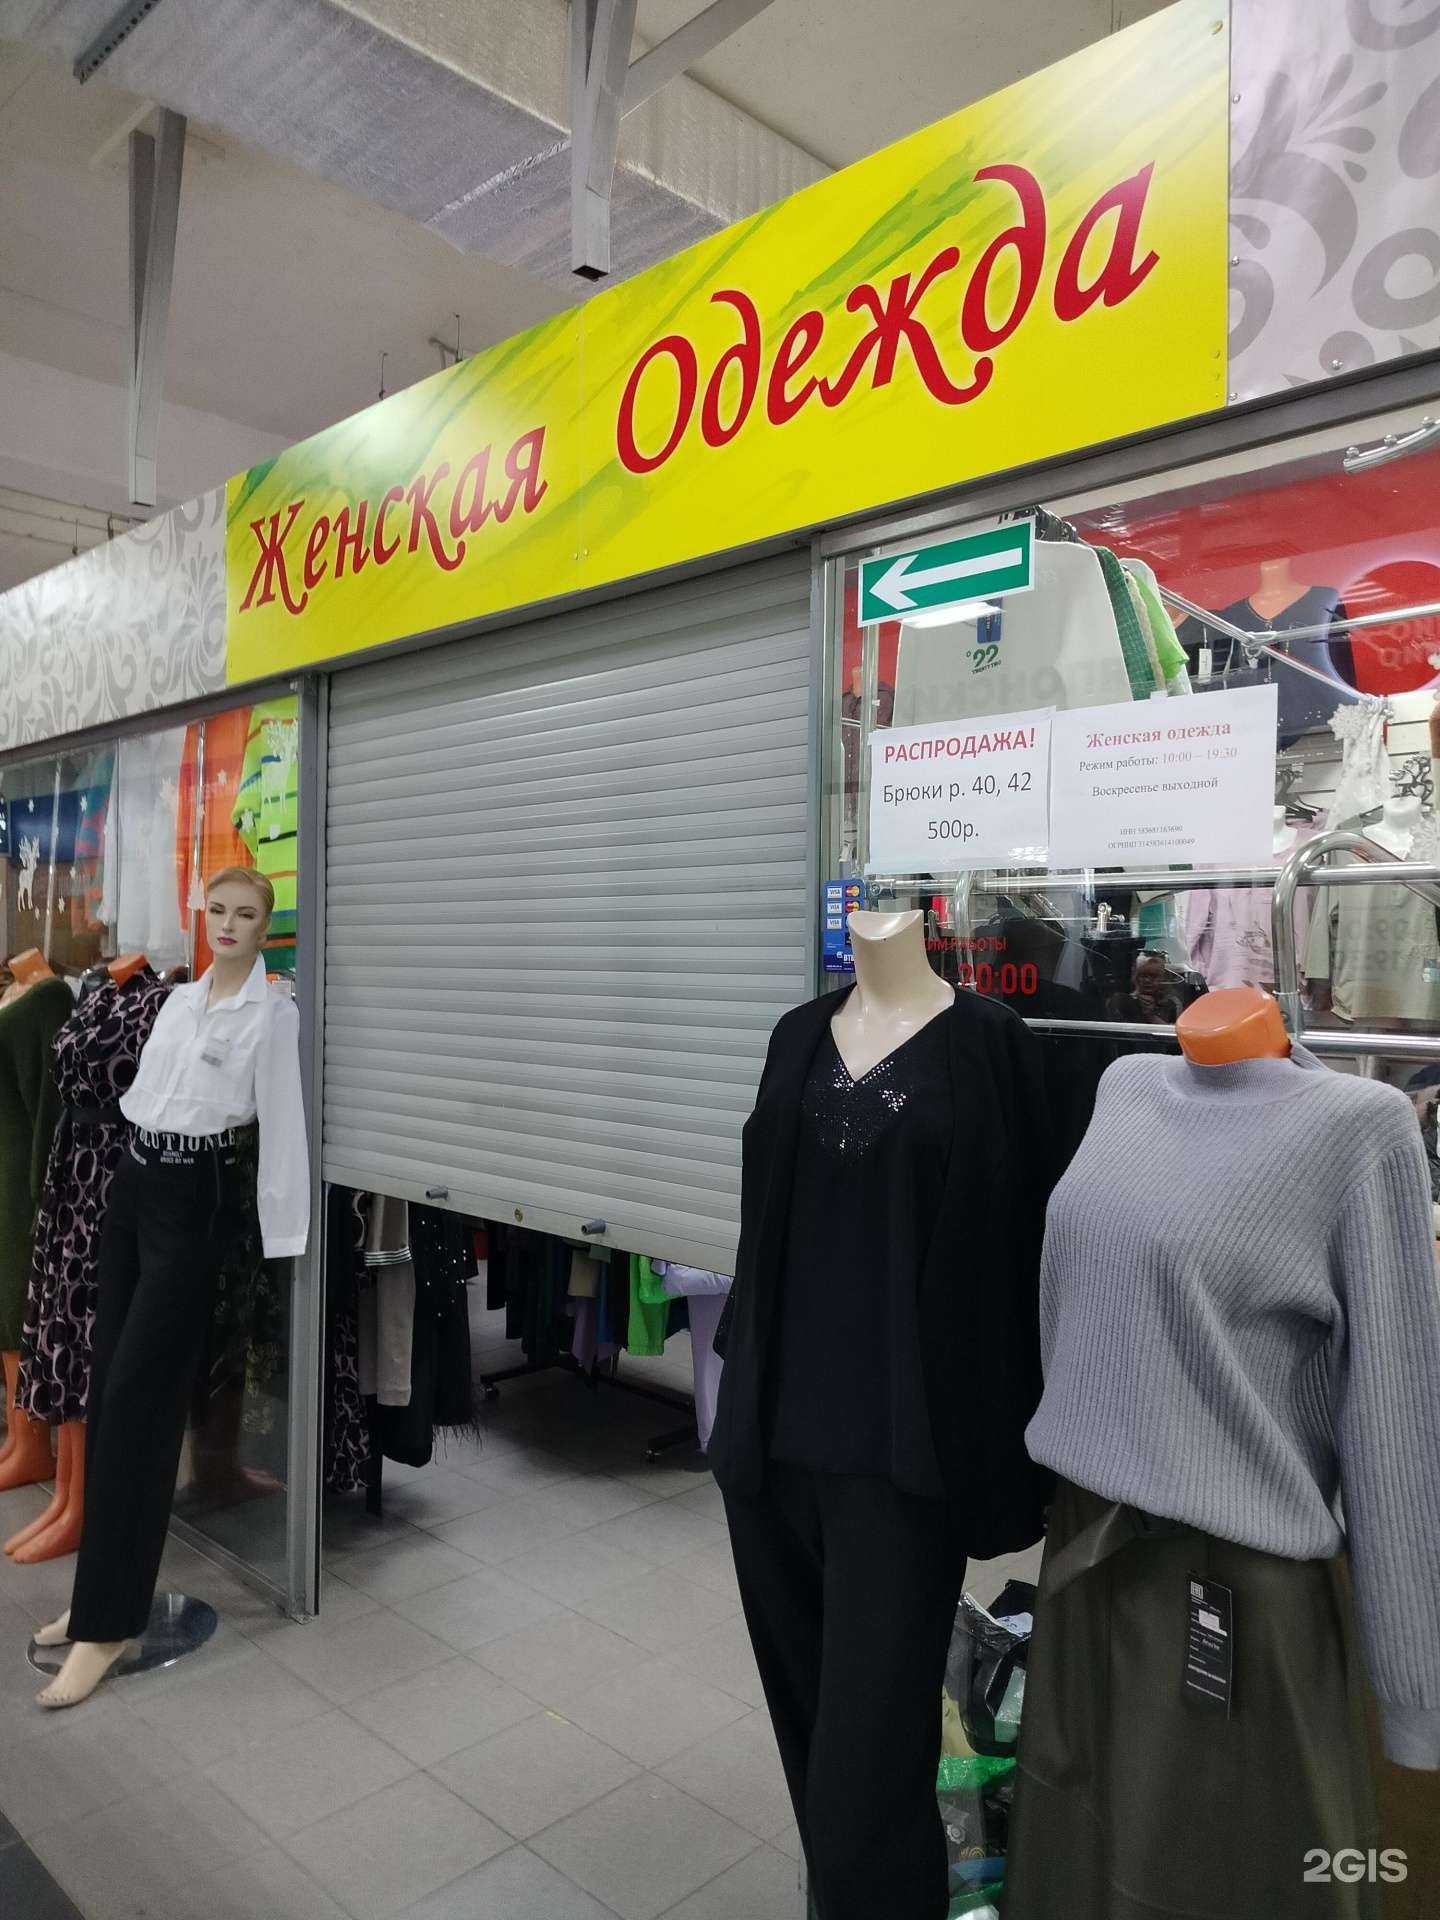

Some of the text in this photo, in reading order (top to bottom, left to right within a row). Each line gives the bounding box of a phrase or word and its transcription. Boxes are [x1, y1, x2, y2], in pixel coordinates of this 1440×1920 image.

[238, 161, 1161, 616] Женская Одежда
[884, 727, 1035, 764] РАСПРОДАЖА!
[1086, 722, 1232, 749] Женская одежда
[1079, 760, 1114, 773] Режим
[1116, 755, 1159, 772] работы:
[1162, 751, 1193, 765] 10:00
[1206, 746, 1239, 761] 19:30
[883, 771, 1032, 807] Брюки р. 40, 42
[1092, 776, 1220, 799] Воскресенье выходной
[927, 819, 979, 843] 500р.
